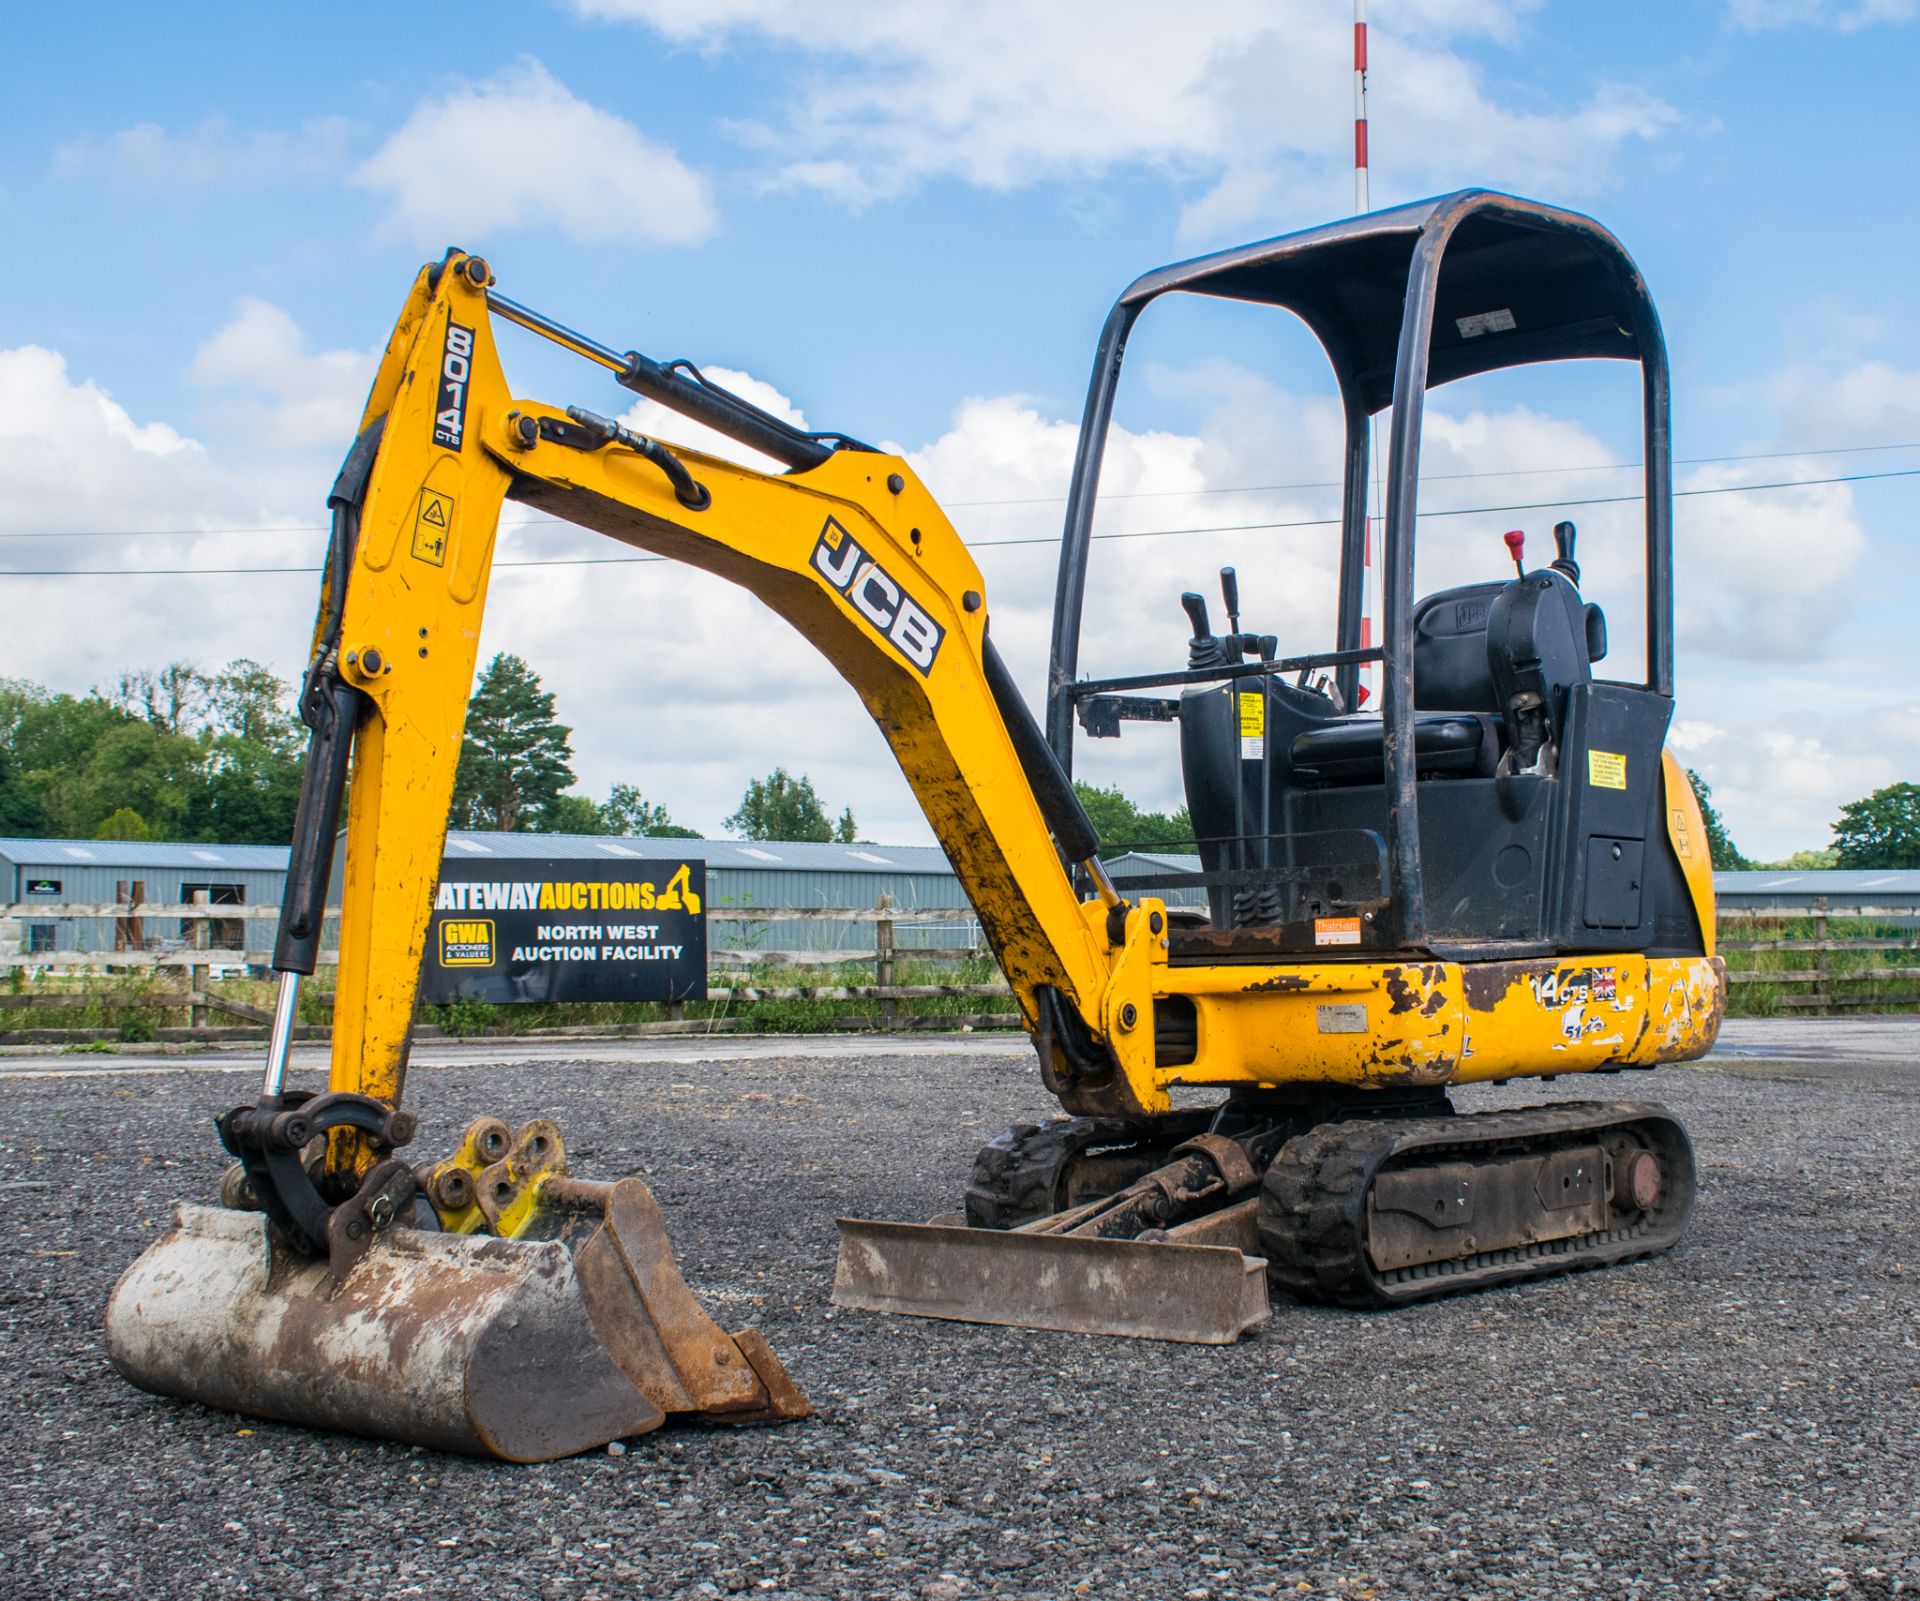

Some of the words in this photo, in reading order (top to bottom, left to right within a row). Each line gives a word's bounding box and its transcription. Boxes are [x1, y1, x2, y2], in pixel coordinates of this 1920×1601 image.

[436, 326, 473, 436] 8014
[436, 429, 461, 446] CTS
[817, 542, 939, 668] JCB
[434, 882, 656, 910] ATEWAYAUCTIONS
[445, 923, 489, 944] GWA
[537, 925, 602, 940] NORTH
[606, 925, 659, 940] WEST
[511, 946, 597, 961] AUCTION
[601, 945, 683, 961] FACILITY
